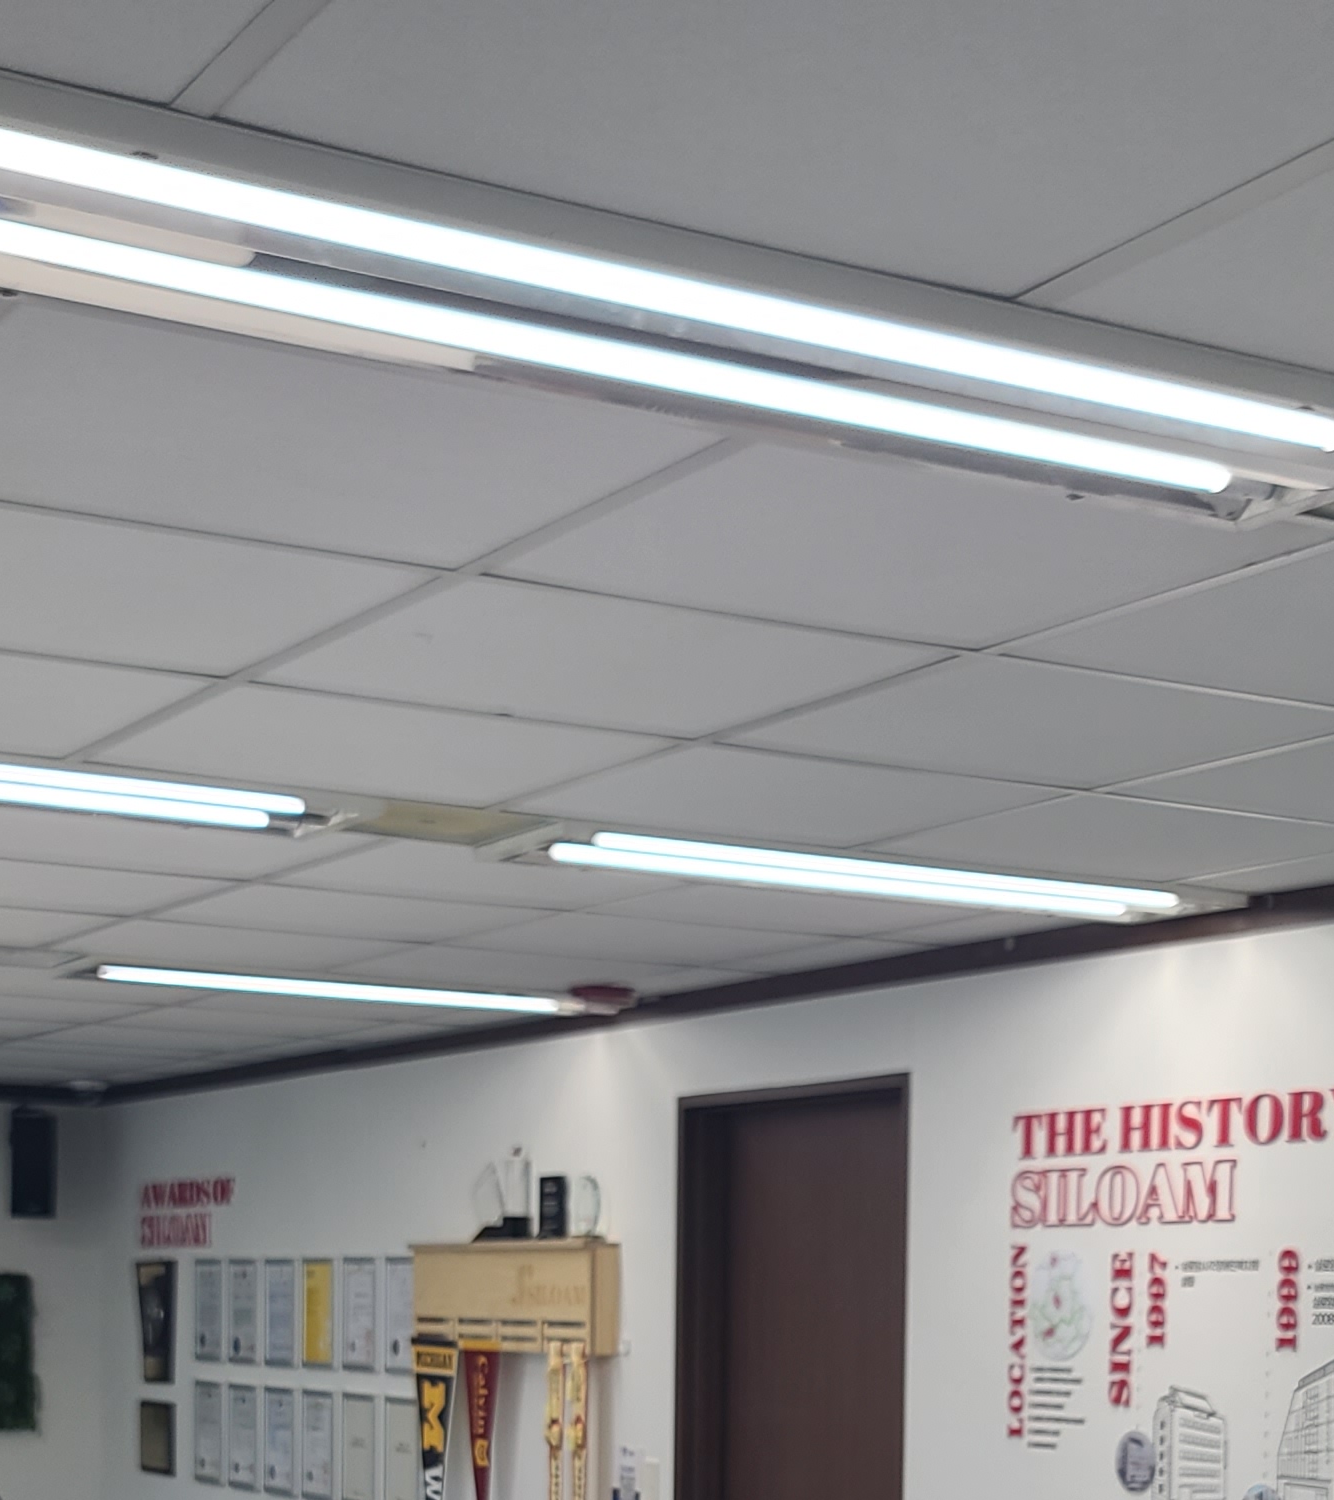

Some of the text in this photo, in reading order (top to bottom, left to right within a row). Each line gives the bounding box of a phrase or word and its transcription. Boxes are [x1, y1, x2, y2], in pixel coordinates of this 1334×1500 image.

[1013, 1108, 1107, 1160] THE
[140, 1177, 236, 1210] AWARDS OF
[1011, 1159, 1237, 1228] SILOAM
[1108, 1252, 1134, 1408] SINCE
[1146, 1252, 1168, 1349] 1997
[1275, 1250, 1299, 1352] 1999
[1312, 1314, 1334, 1325] 2008
[1007, 1245, 1028, 1438] LOCATION
[422, 1380, 447, 1453] M
